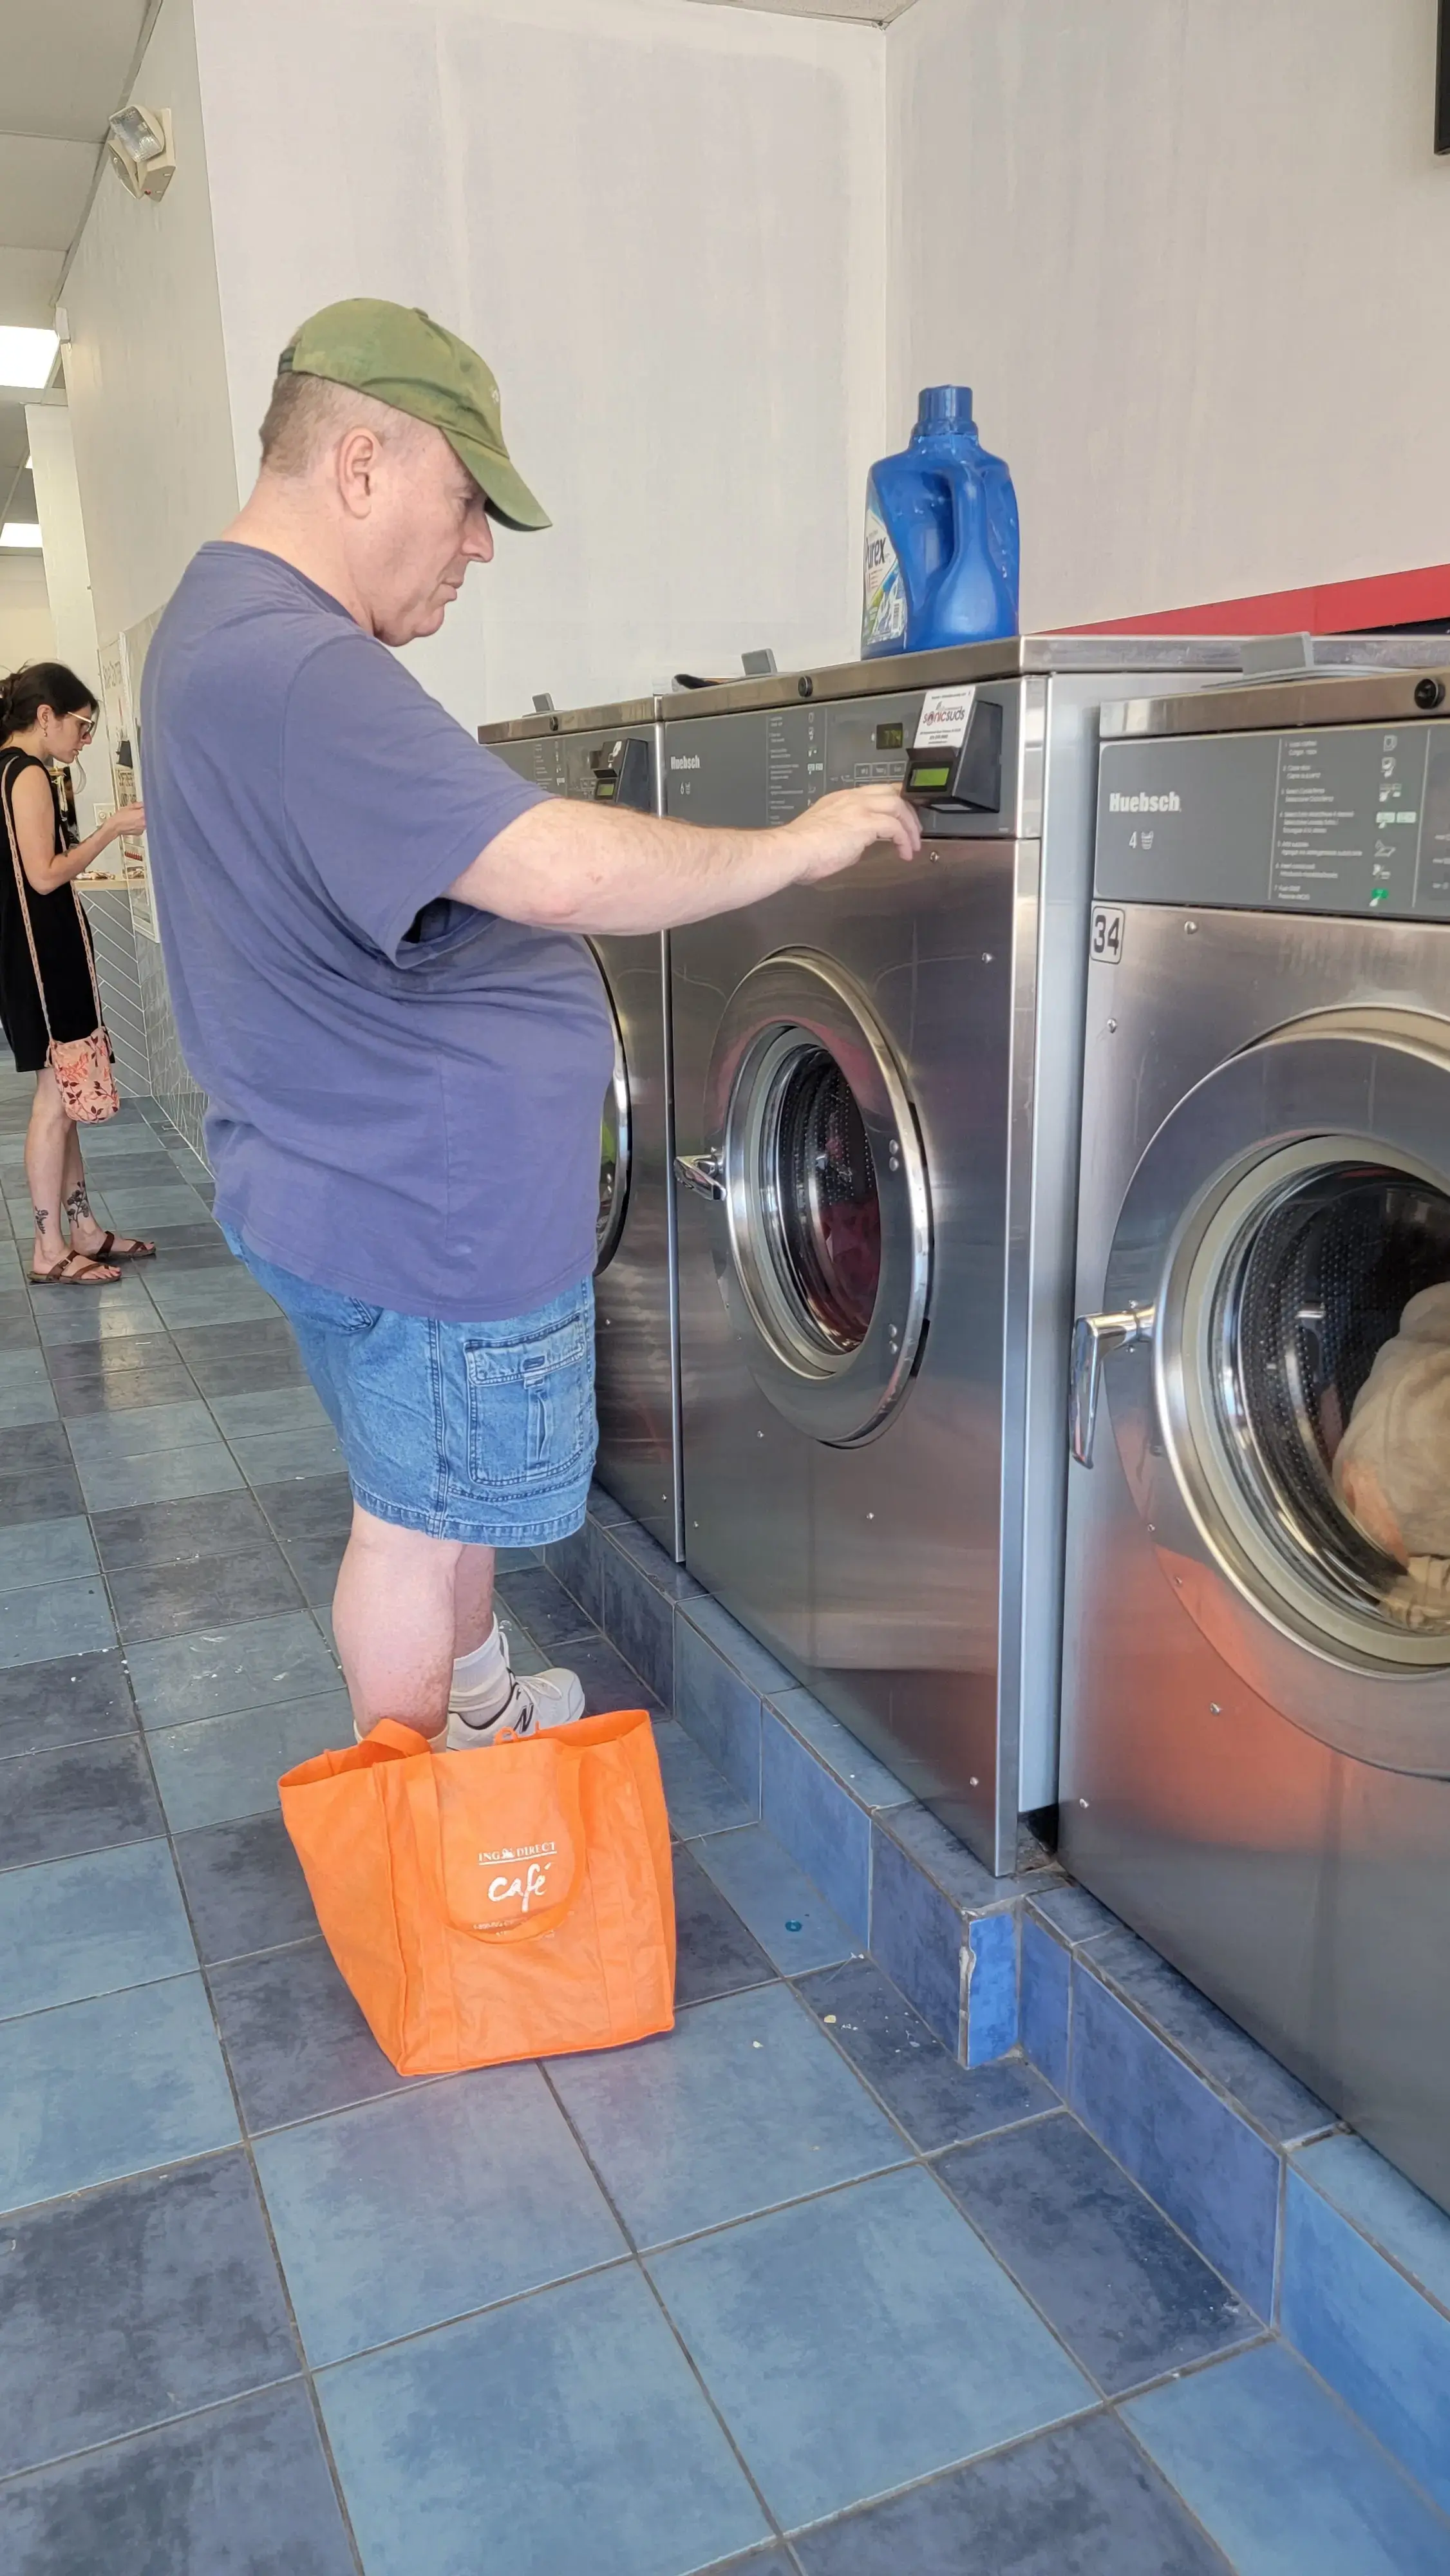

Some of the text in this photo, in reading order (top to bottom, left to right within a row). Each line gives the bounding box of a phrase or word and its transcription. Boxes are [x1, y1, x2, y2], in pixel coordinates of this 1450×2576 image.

[923, 706, 966, 726] sonicsuds
[671, 755, 701, 770] Huebsch
[1109, 791, 1180, 813] Huebsch
[1129, 831, 1137, 849] 4
[1093, 914, 1120, 956] 34
[478, 1842, 556, 1862] ING DIRECT
[487, 1862, 552, 1913] café
